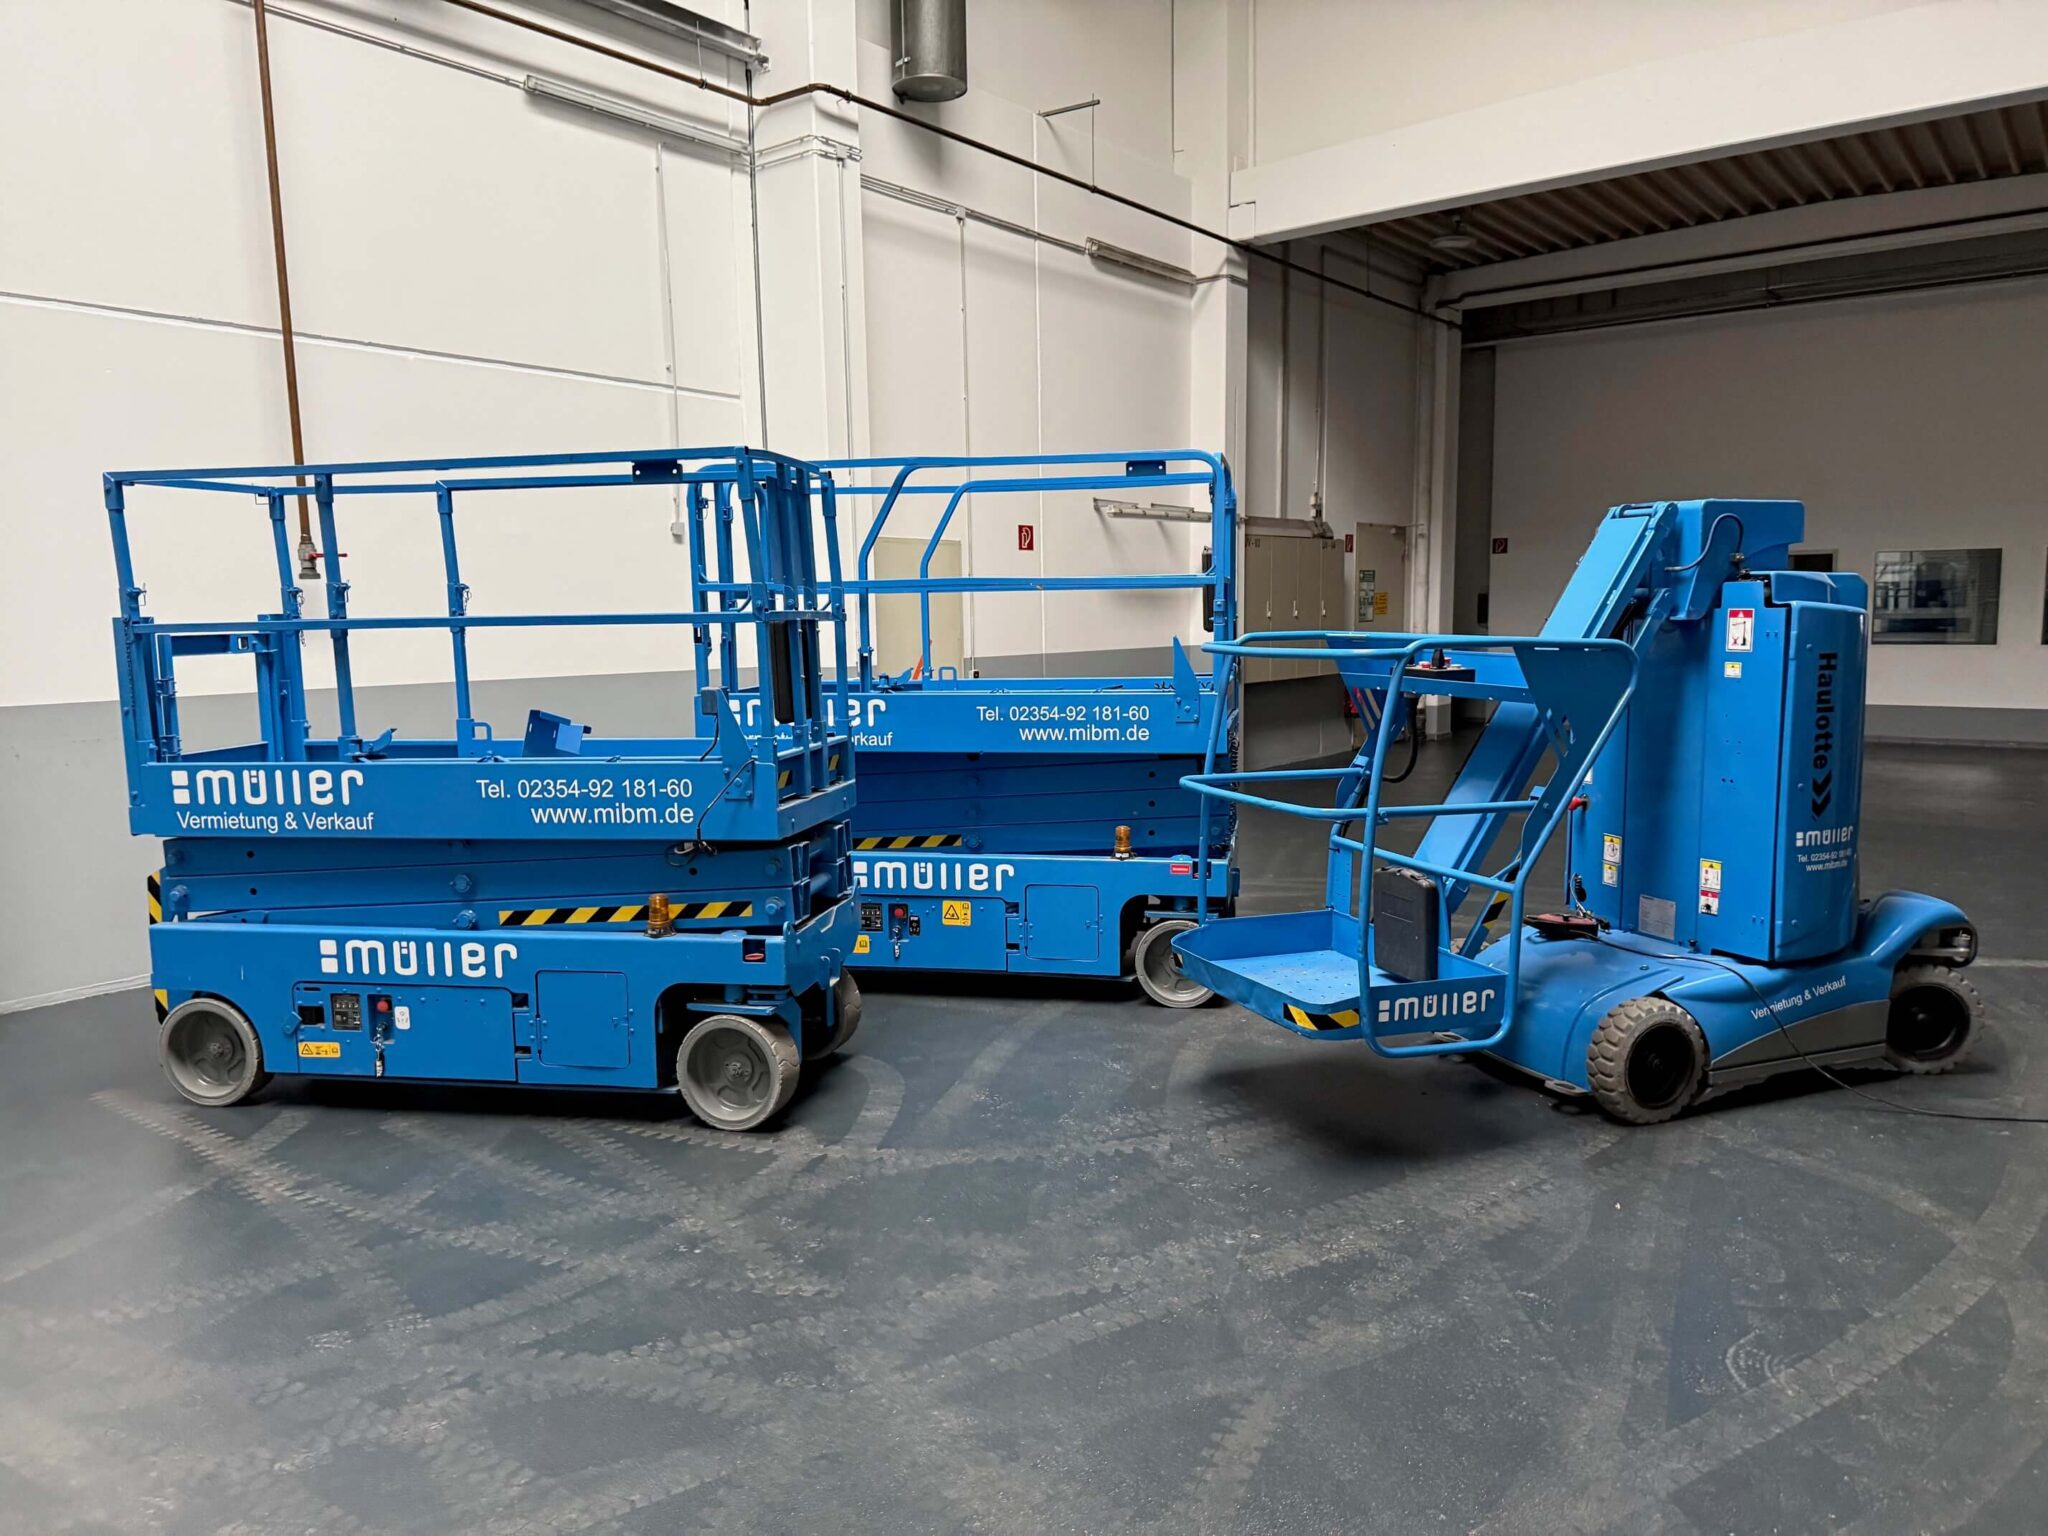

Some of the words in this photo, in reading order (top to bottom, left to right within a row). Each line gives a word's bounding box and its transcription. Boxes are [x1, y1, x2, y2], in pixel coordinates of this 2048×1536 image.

[976, 706, 1004, 721] Tel.
[1009, 706, 1086, 721] 02354-92
[1093, 705, 1150, 721] 181-60
[1812, 652, 1838, 770] Haulotte
[1019, 724, 1150, 741] www.mibm.de
[196, 769, 364, 805] müller
[476, 779, 511, 798] Tel.
[517, 779, 614, 798] 02354-92
[621, 778, 693, 798] 181-60
[176, 811, 279, 834] Vermietung
[284, 812, 298, 829] &
[302, 812, 374, 831] Verkauf
[530, 803, 694, 824] www.mibm.de
[1805, 825, 1854, 847] müller
[873, 861, 1015, 892] müller
[344, 939, 518, 979] müller
[1803, 989, 1812, 1001] &
[1812, 975, 1846, 997] Verkauf
[1394, 988, 1496, 1022] müller
